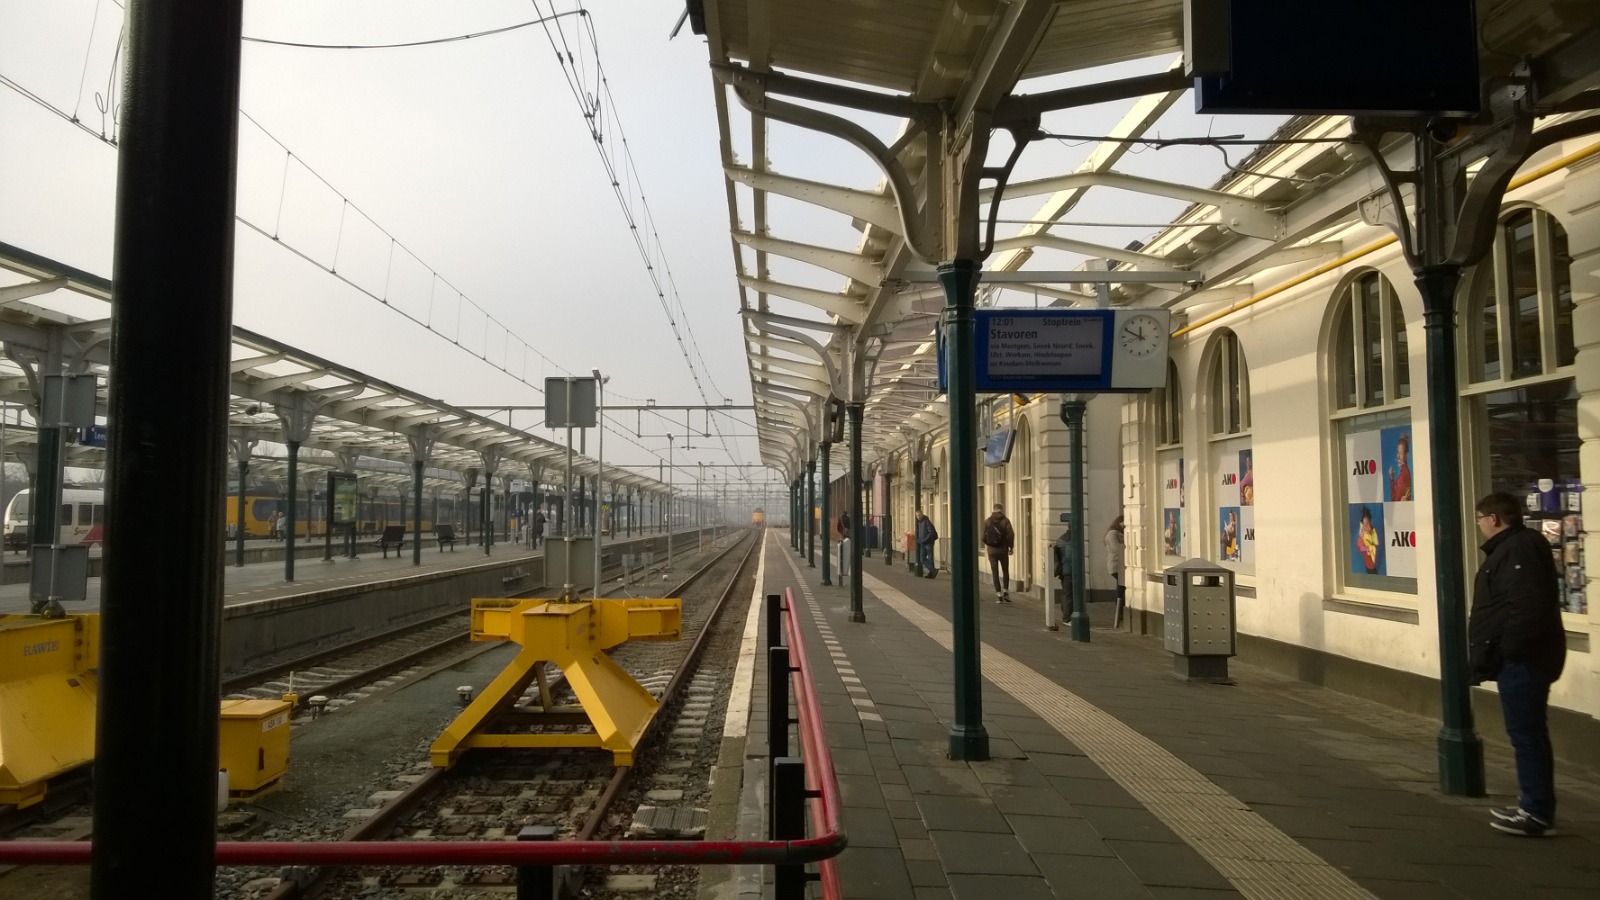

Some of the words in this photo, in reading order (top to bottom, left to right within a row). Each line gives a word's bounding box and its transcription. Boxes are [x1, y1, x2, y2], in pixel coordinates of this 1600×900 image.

[992, 318, 1014, 326] 12:01
[1043, 318, 1081, 327] Stoptrein
[990, 328, 1038, 340] Stavoren
[1075, 342, 1095, 350] Sneek,
[1353, 459, 1377, 475] AKO
[1166, 478, 1178, 489] AKO
[1222, 473, 1237, 485] AKO
[1391, 531, 1416, 547] AKO
[23, 640, 59, 656] RAWIE
